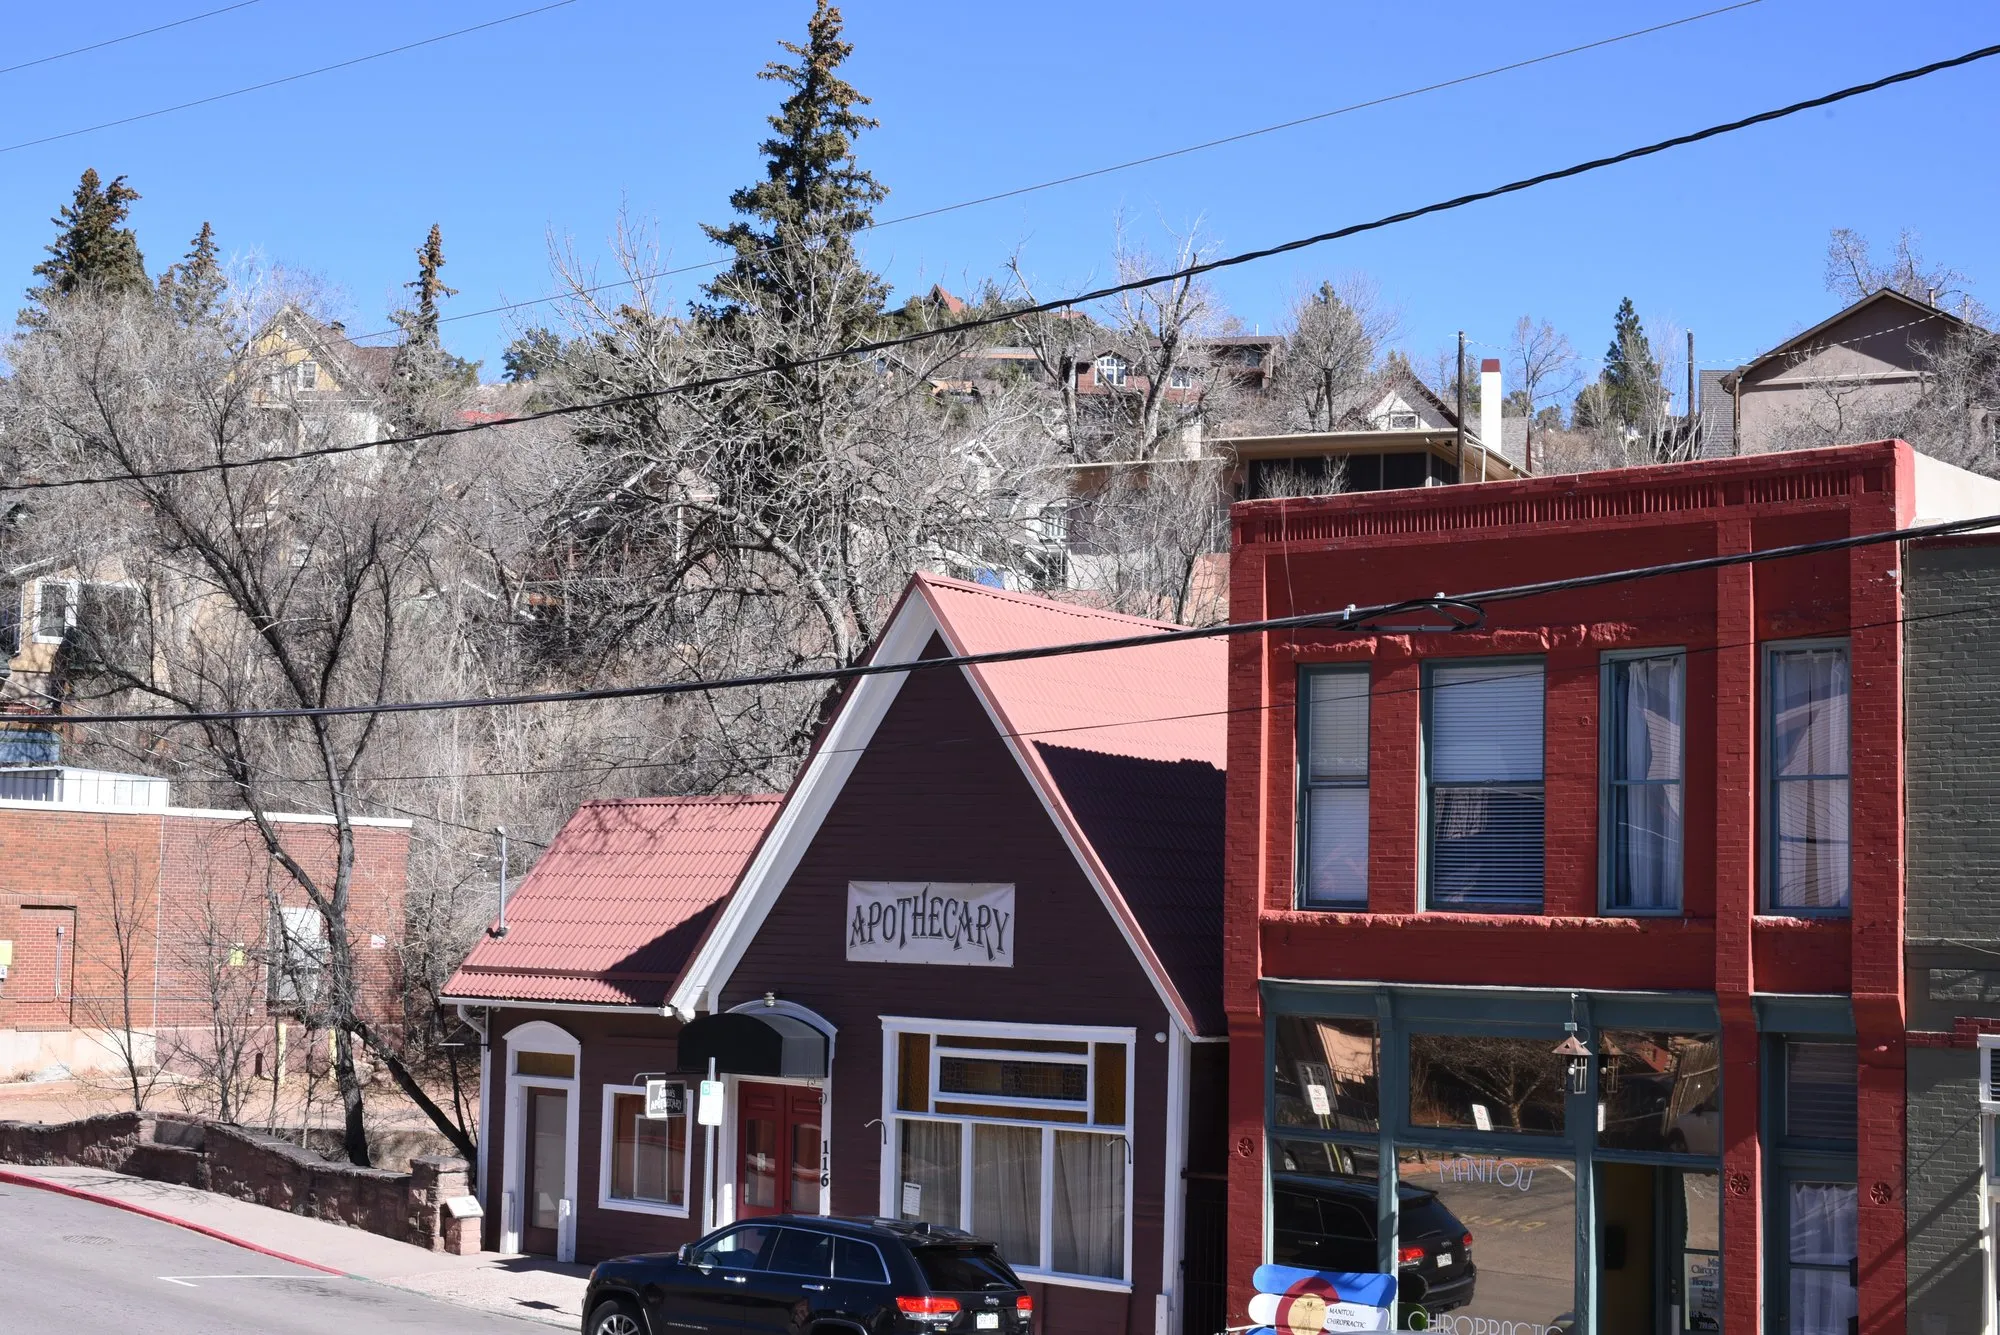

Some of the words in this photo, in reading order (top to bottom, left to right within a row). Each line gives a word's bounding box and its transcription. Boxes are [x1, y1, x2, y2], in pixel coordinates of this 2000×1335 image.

[850, 884, 1010, 961] APOTHECARY
[821, 1140, 830, 1187] 116
[1439, 1158, 1534, 1191] MANITOU
[1326, 1317, 1367, 1328] CHIROPRACTIC
[1329, 1307, 1355, 1317] MANITOU
